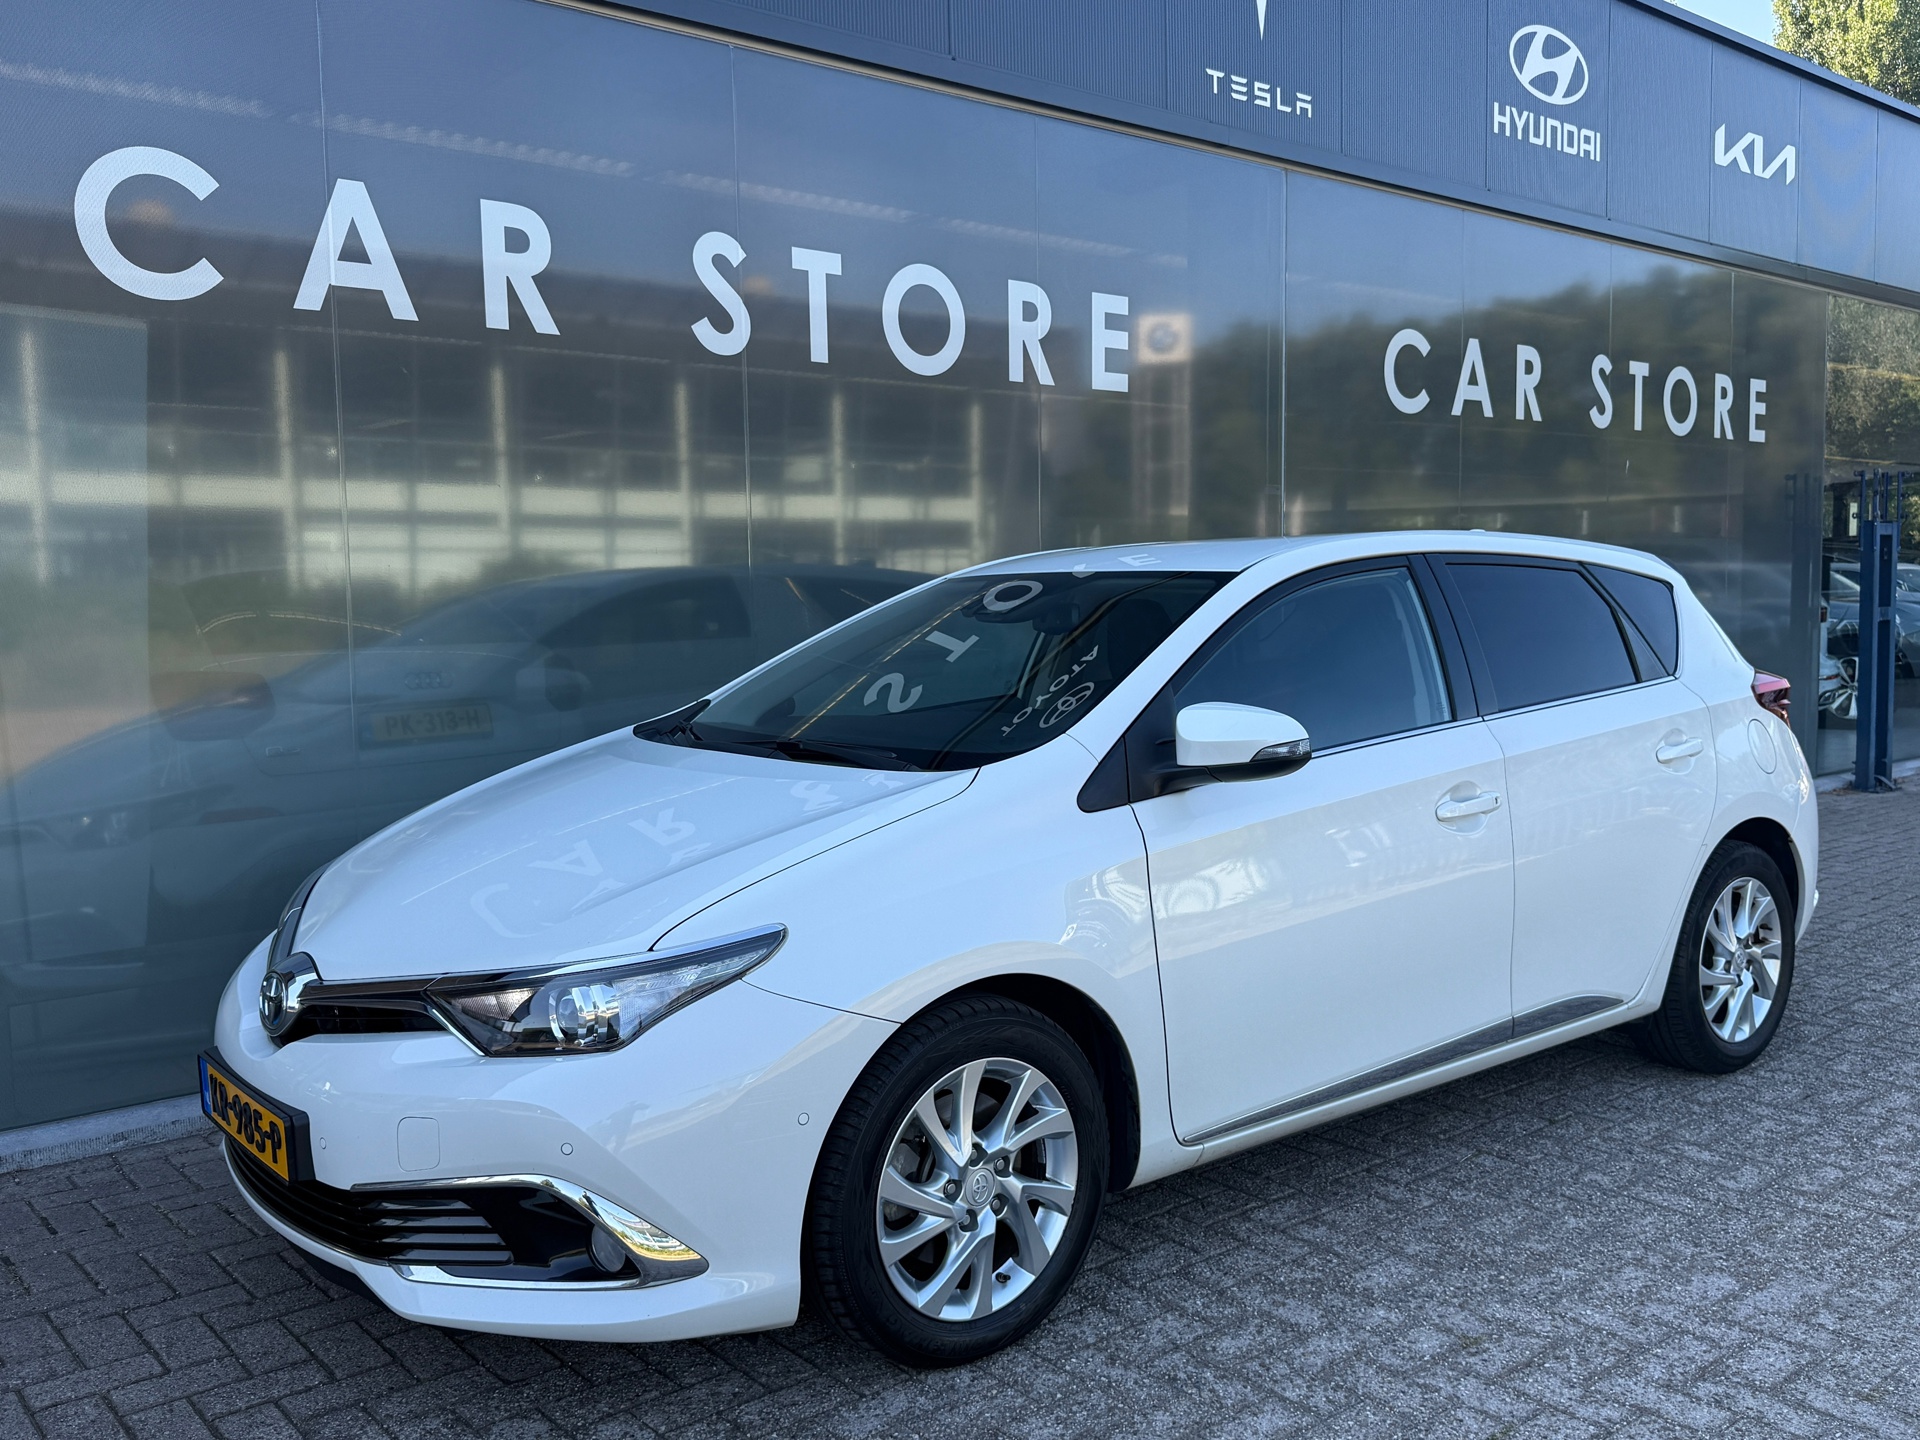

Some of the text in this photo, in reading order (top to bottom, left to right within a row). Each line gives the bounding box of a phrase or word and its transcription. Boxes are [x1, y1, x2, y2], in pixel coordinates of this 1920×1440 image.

[1205, 67, 1312, 119] TESLA
[1493, 101, 1601, 162] HYUNDAI
[1714, 123, 1796, 186] KIA
[74, 145, 1129, 393] CAR STORE
[1384, 328, 1768, 443] CAR STORE
[209, 1073, 282, 1164] KR-985-P
